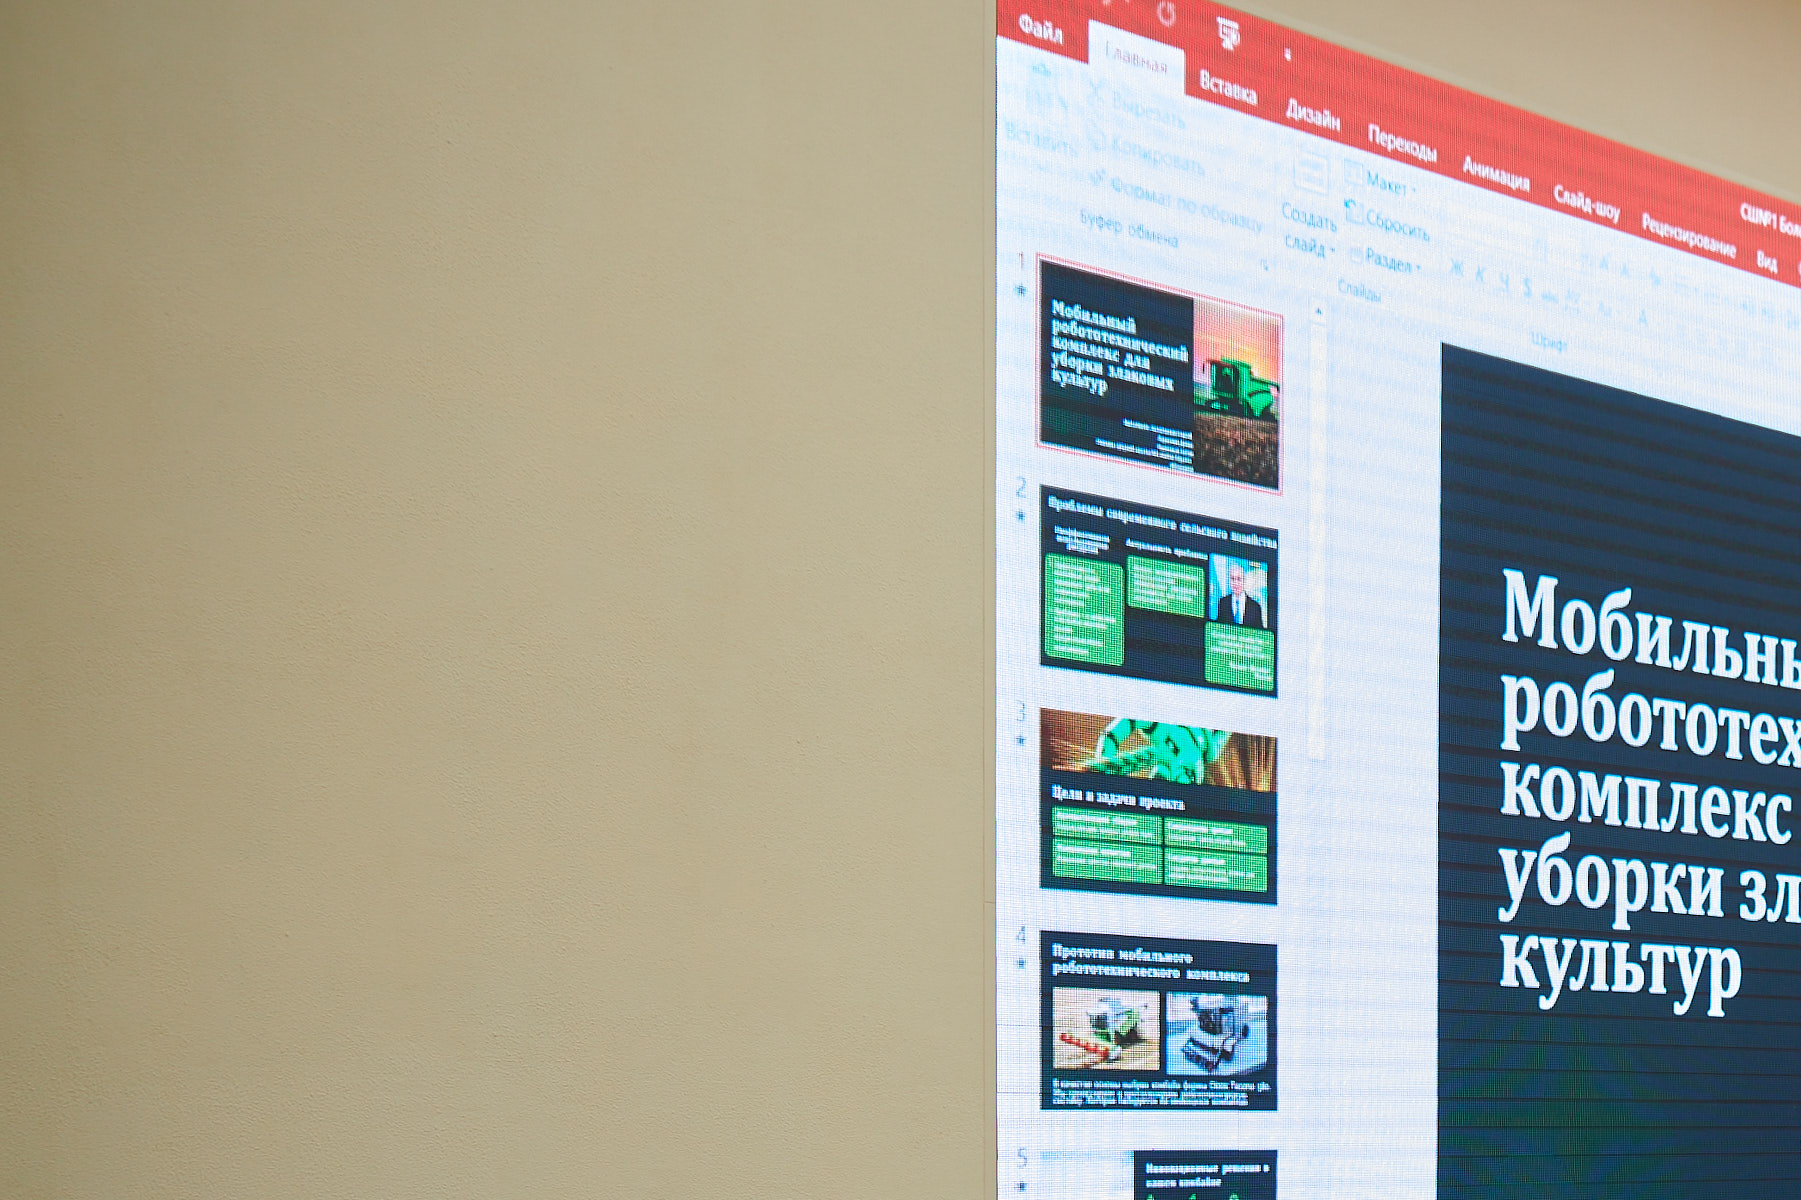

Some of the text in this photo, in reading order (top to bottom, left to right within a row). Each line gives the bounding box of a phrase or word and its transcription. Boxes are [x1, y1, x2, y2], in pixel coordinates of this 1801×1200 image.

[1018, 12, 1064, 45] Файл
[1200, 69, 1258, 106] Вставка
[1286, 97, 1341, 133] Дизайн
[1368, 122, 1437, 163] Переходы
[1366, 168, 1408, 198] Макет
[1463, 155, 1531, 193] Анимация
[1281, 200, 1339, 235] Создать
[1554, 184, 1622, 226] Слайд-шоу
[1366, 207, 1432, 244] Сбросить
[1642, 212, 1738, 260] Рецензирование
[1283, 231, 1328, 260] слайд
[1365, 245, 1414, 276] Раздел
[1757, 249, 1778, 275] Вид
[1051, 783, 1083, 802] Цели
[1500, 761, 1793, 845] комплекс
[1497, 831, 1726, 931] уборки
[1051, 942, 1115, 961] Прототип
[1500, 932, 1742, 1018] культур
